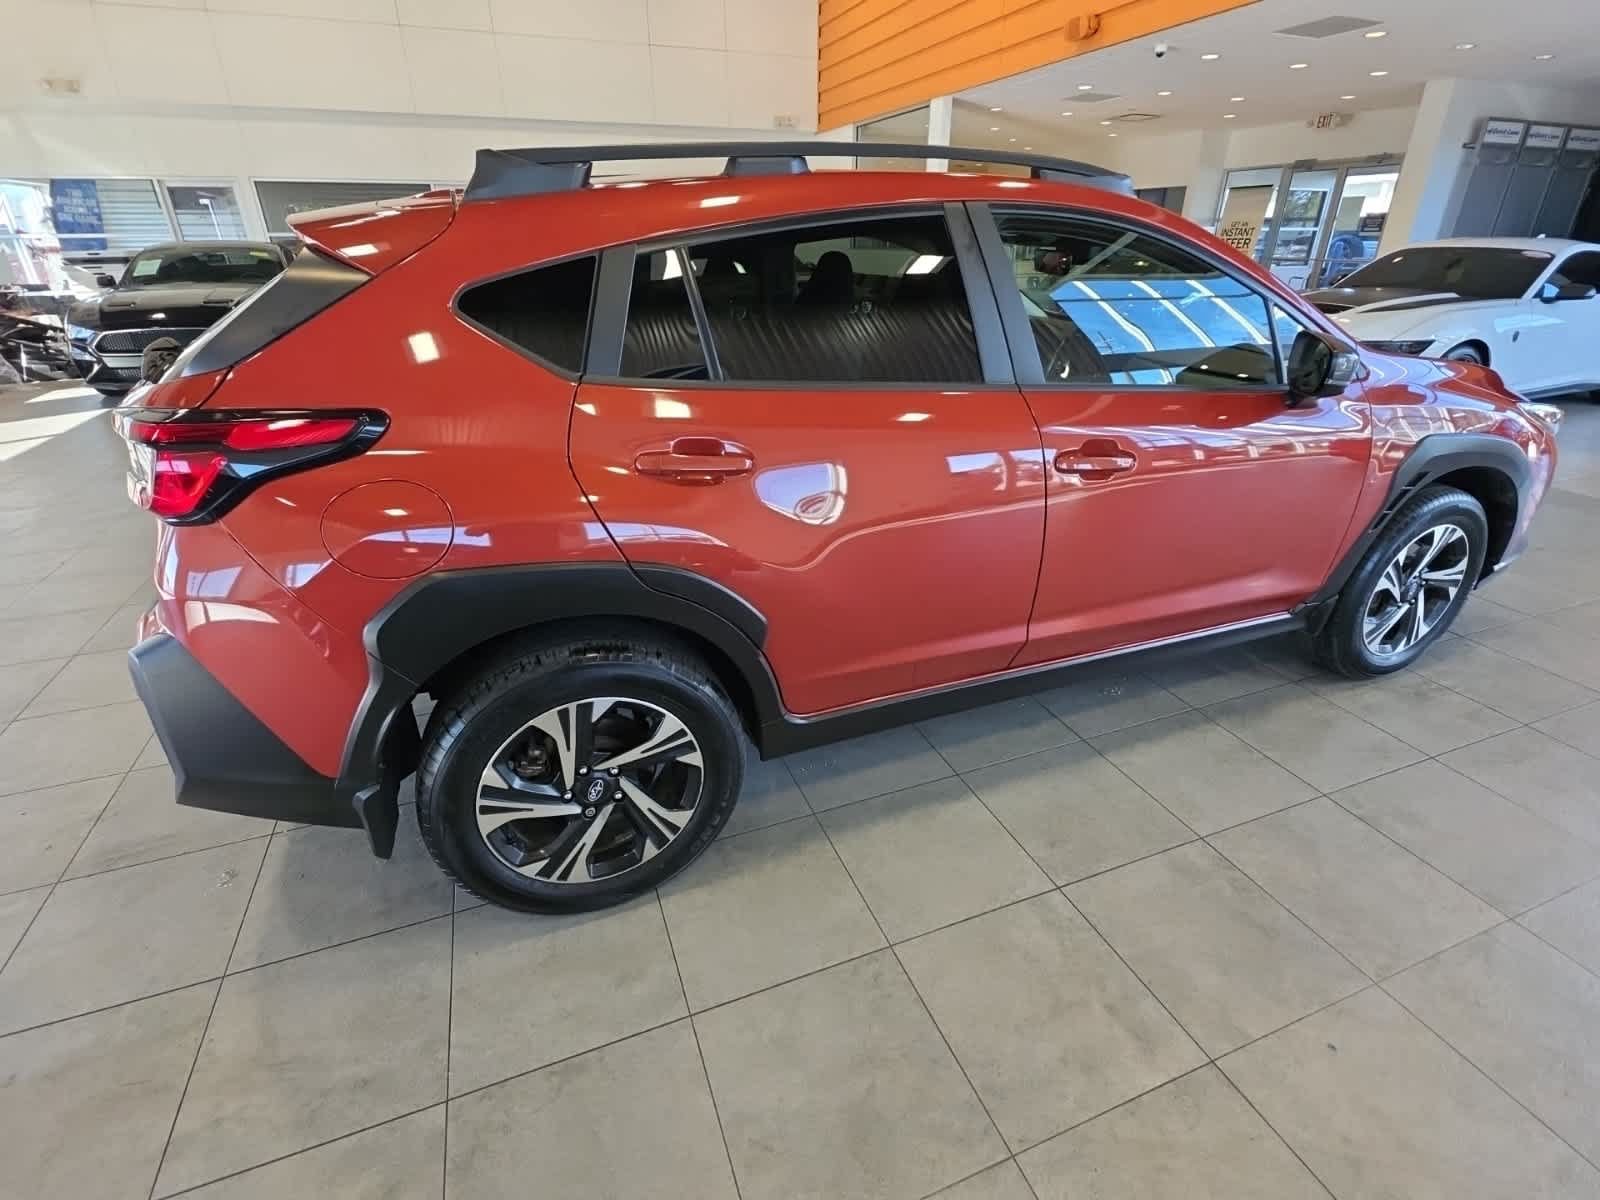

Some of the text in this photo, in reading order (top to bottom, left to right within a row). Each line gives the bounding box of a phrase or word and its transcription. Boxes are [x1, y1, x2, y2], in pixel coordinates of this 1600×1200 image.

[1316, 114, 1335, 129] EXIT
[1220, 227, 1255, 237] INSTANT
[1222, 238, 1251, 249] FFER
